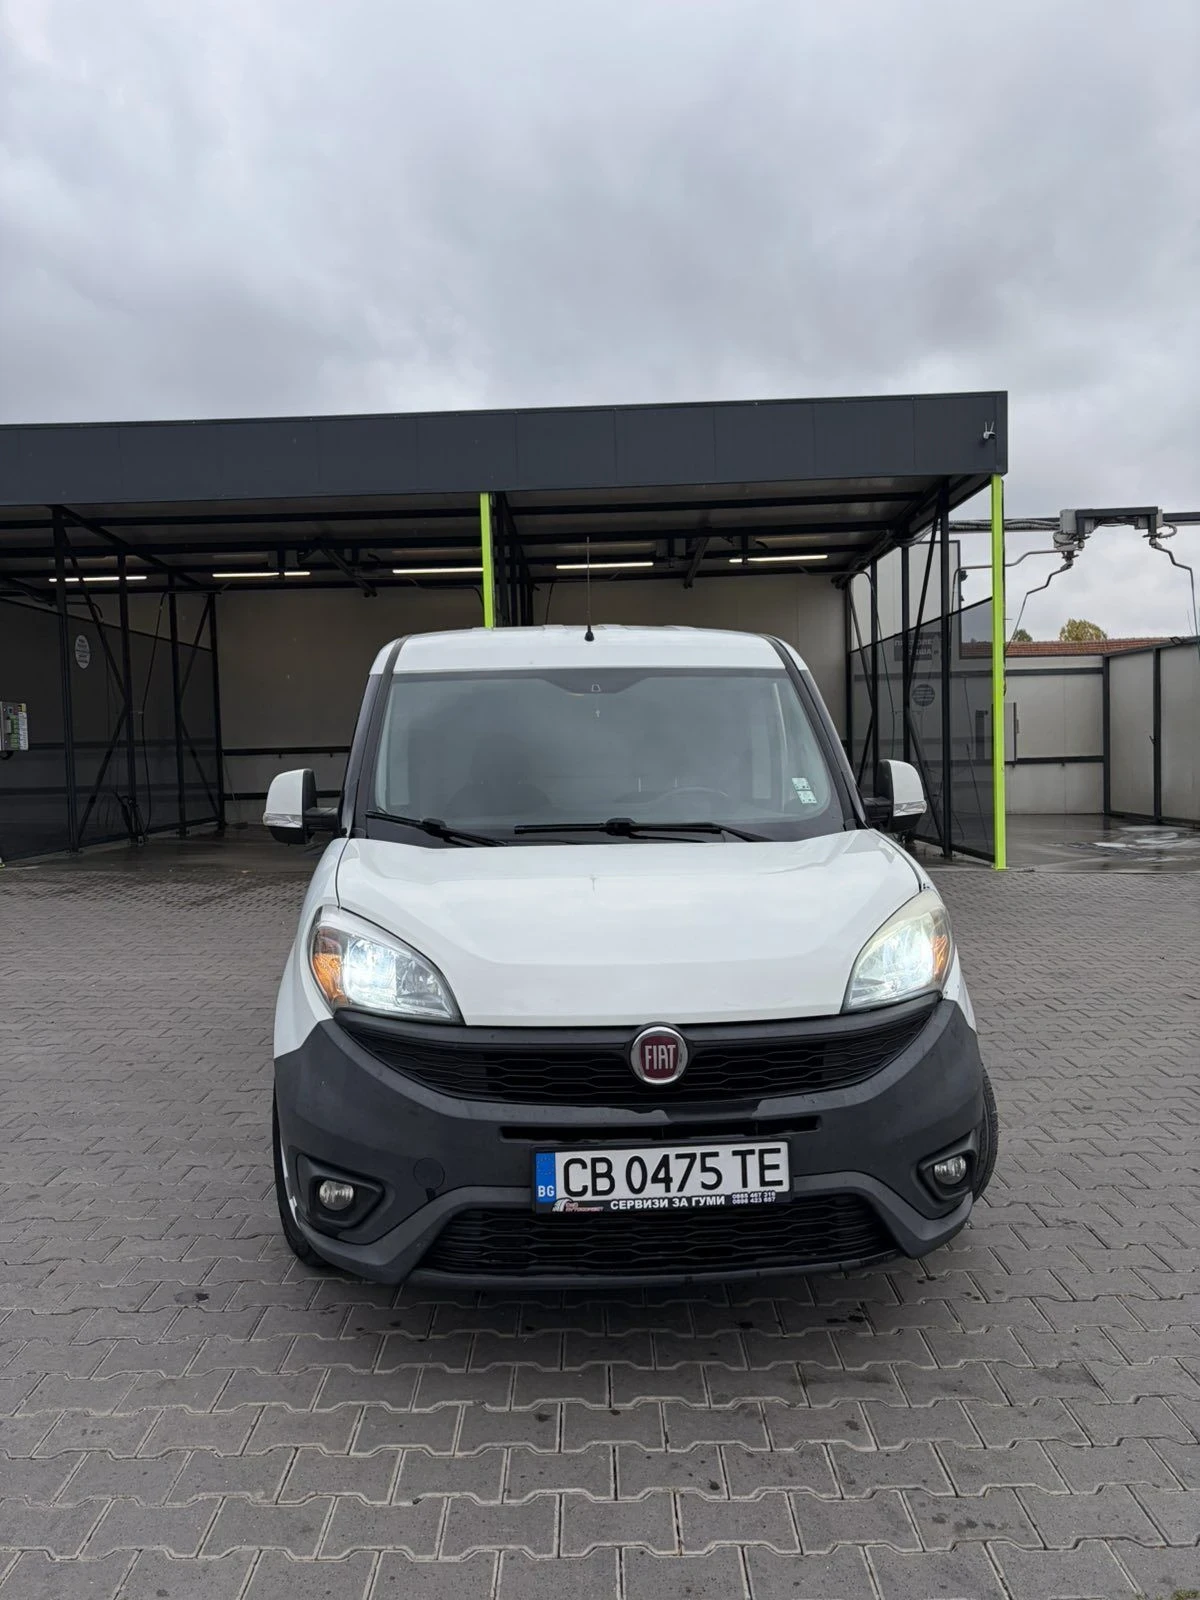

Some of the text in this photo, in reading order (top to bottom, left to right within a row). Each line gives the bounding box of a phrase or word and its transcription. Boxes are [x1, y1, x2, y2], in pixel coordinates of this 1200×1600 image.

[644, 1044, 677, 1070] FIAT
[563, 1147, 784, 1197] CB 0475 TE
[538, 1185, 555, 1198] BG
[610, 1198, 669, 1210] СЕРВИЗИ
[672, 1197, 689, 1208] ЗА
[691, 1195, 726, 1207] ГУМИ
